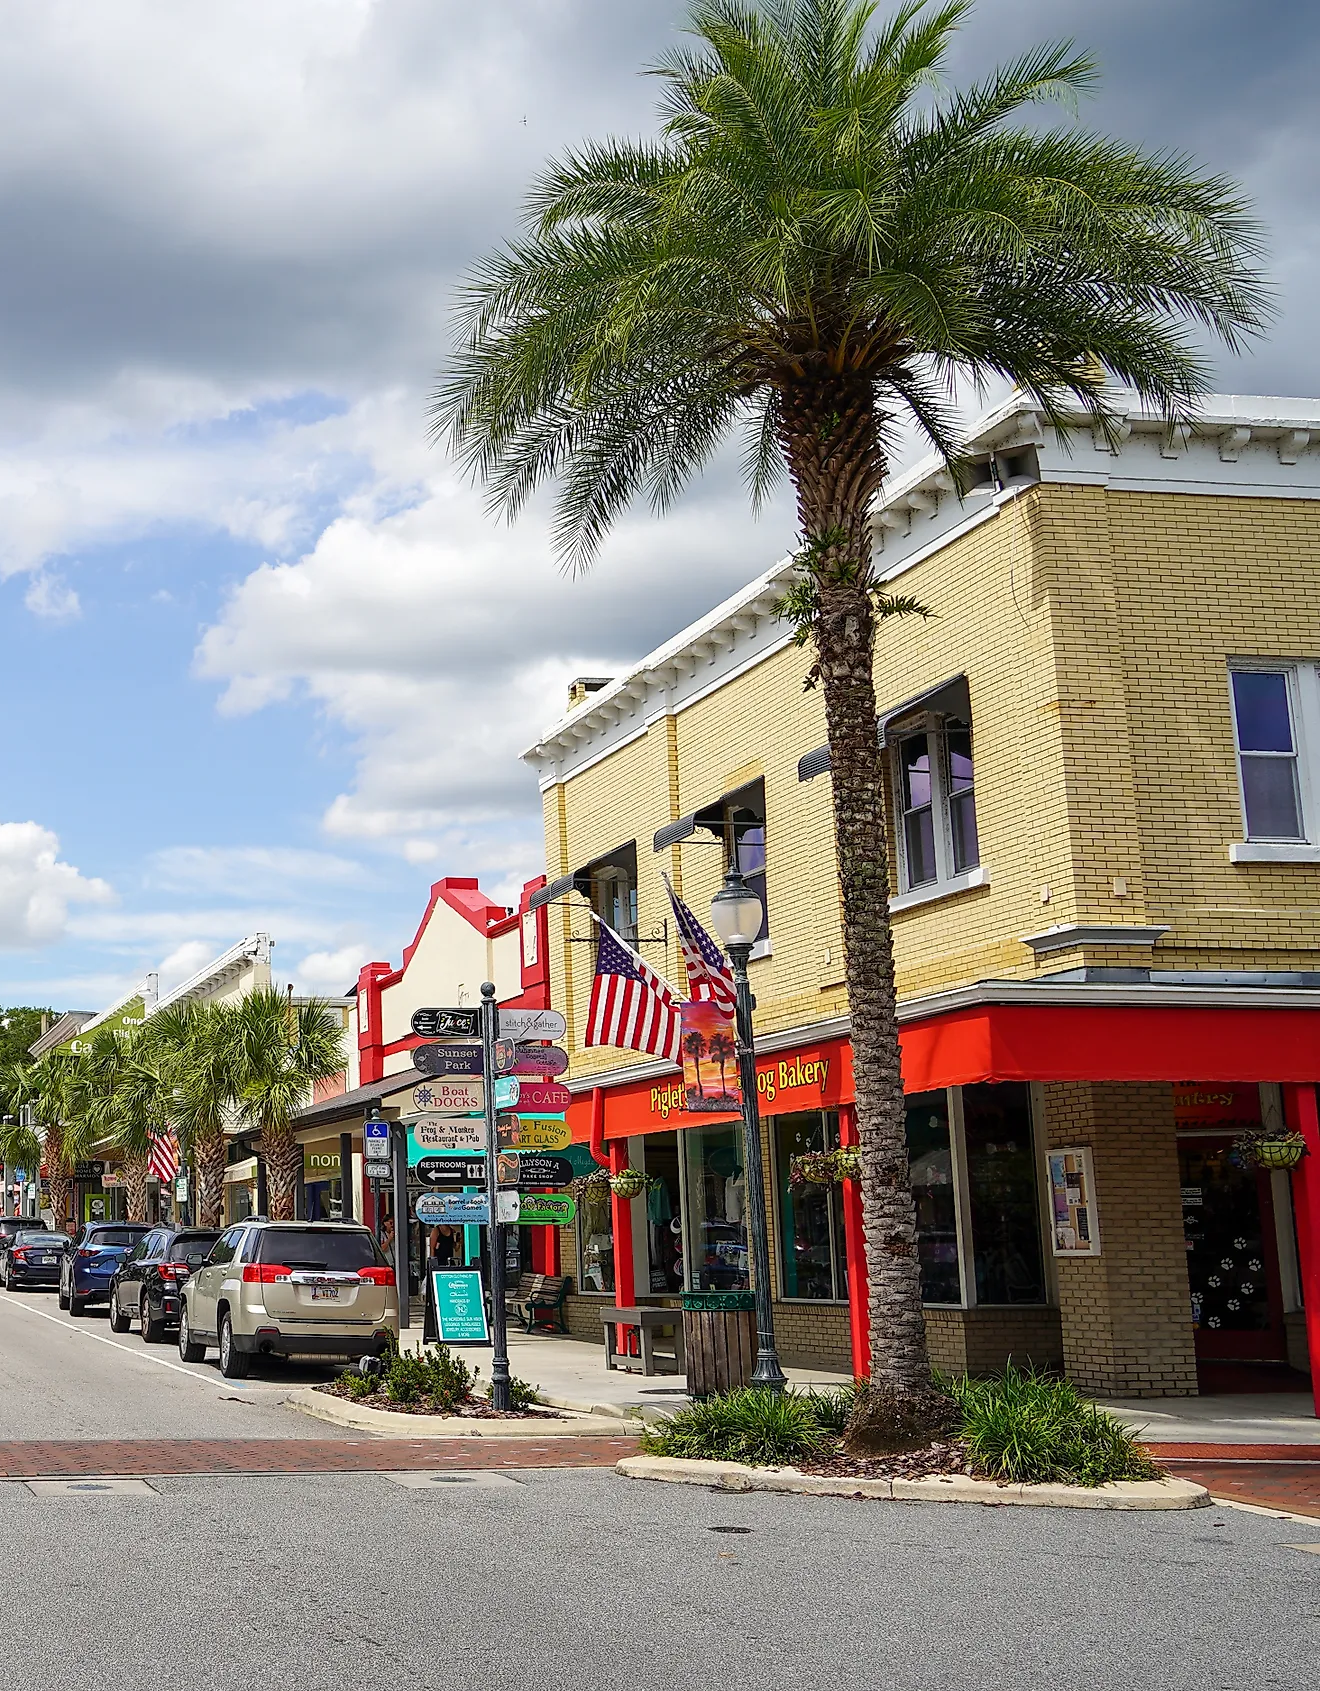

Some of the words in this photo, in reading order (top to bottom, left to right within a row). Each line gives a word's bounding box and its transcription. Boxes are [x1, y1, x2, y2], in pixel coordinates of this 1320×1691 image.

[122, 1016, 144, 1026] One
[437, 1048, 478, 1058] Sunset
[444, 1060, 471, 1070] Park
[441, 1085, 469, 1096] Boat
[650, 1082, 688, 1118] Piglet's
[753, 1070, 776, 1101] og
[778, 1055, 830, 1092] Bakery
[532, 1090, 569, 1104] CAFE
[434, 1097, 478, 1108] DOCKS
[420, 1126, 437, 1135] Frog
[534, 1121, 567, 1138] Fusion
[421, 1134, 458, 1143] Restaurant
[466, 1135, 480, 1143] Pub
[533, 1134, 560, 1144] GLASS
[420, 1161, 467, 1169] RESTROOMS
[553, 1162, 560, 1170] A
